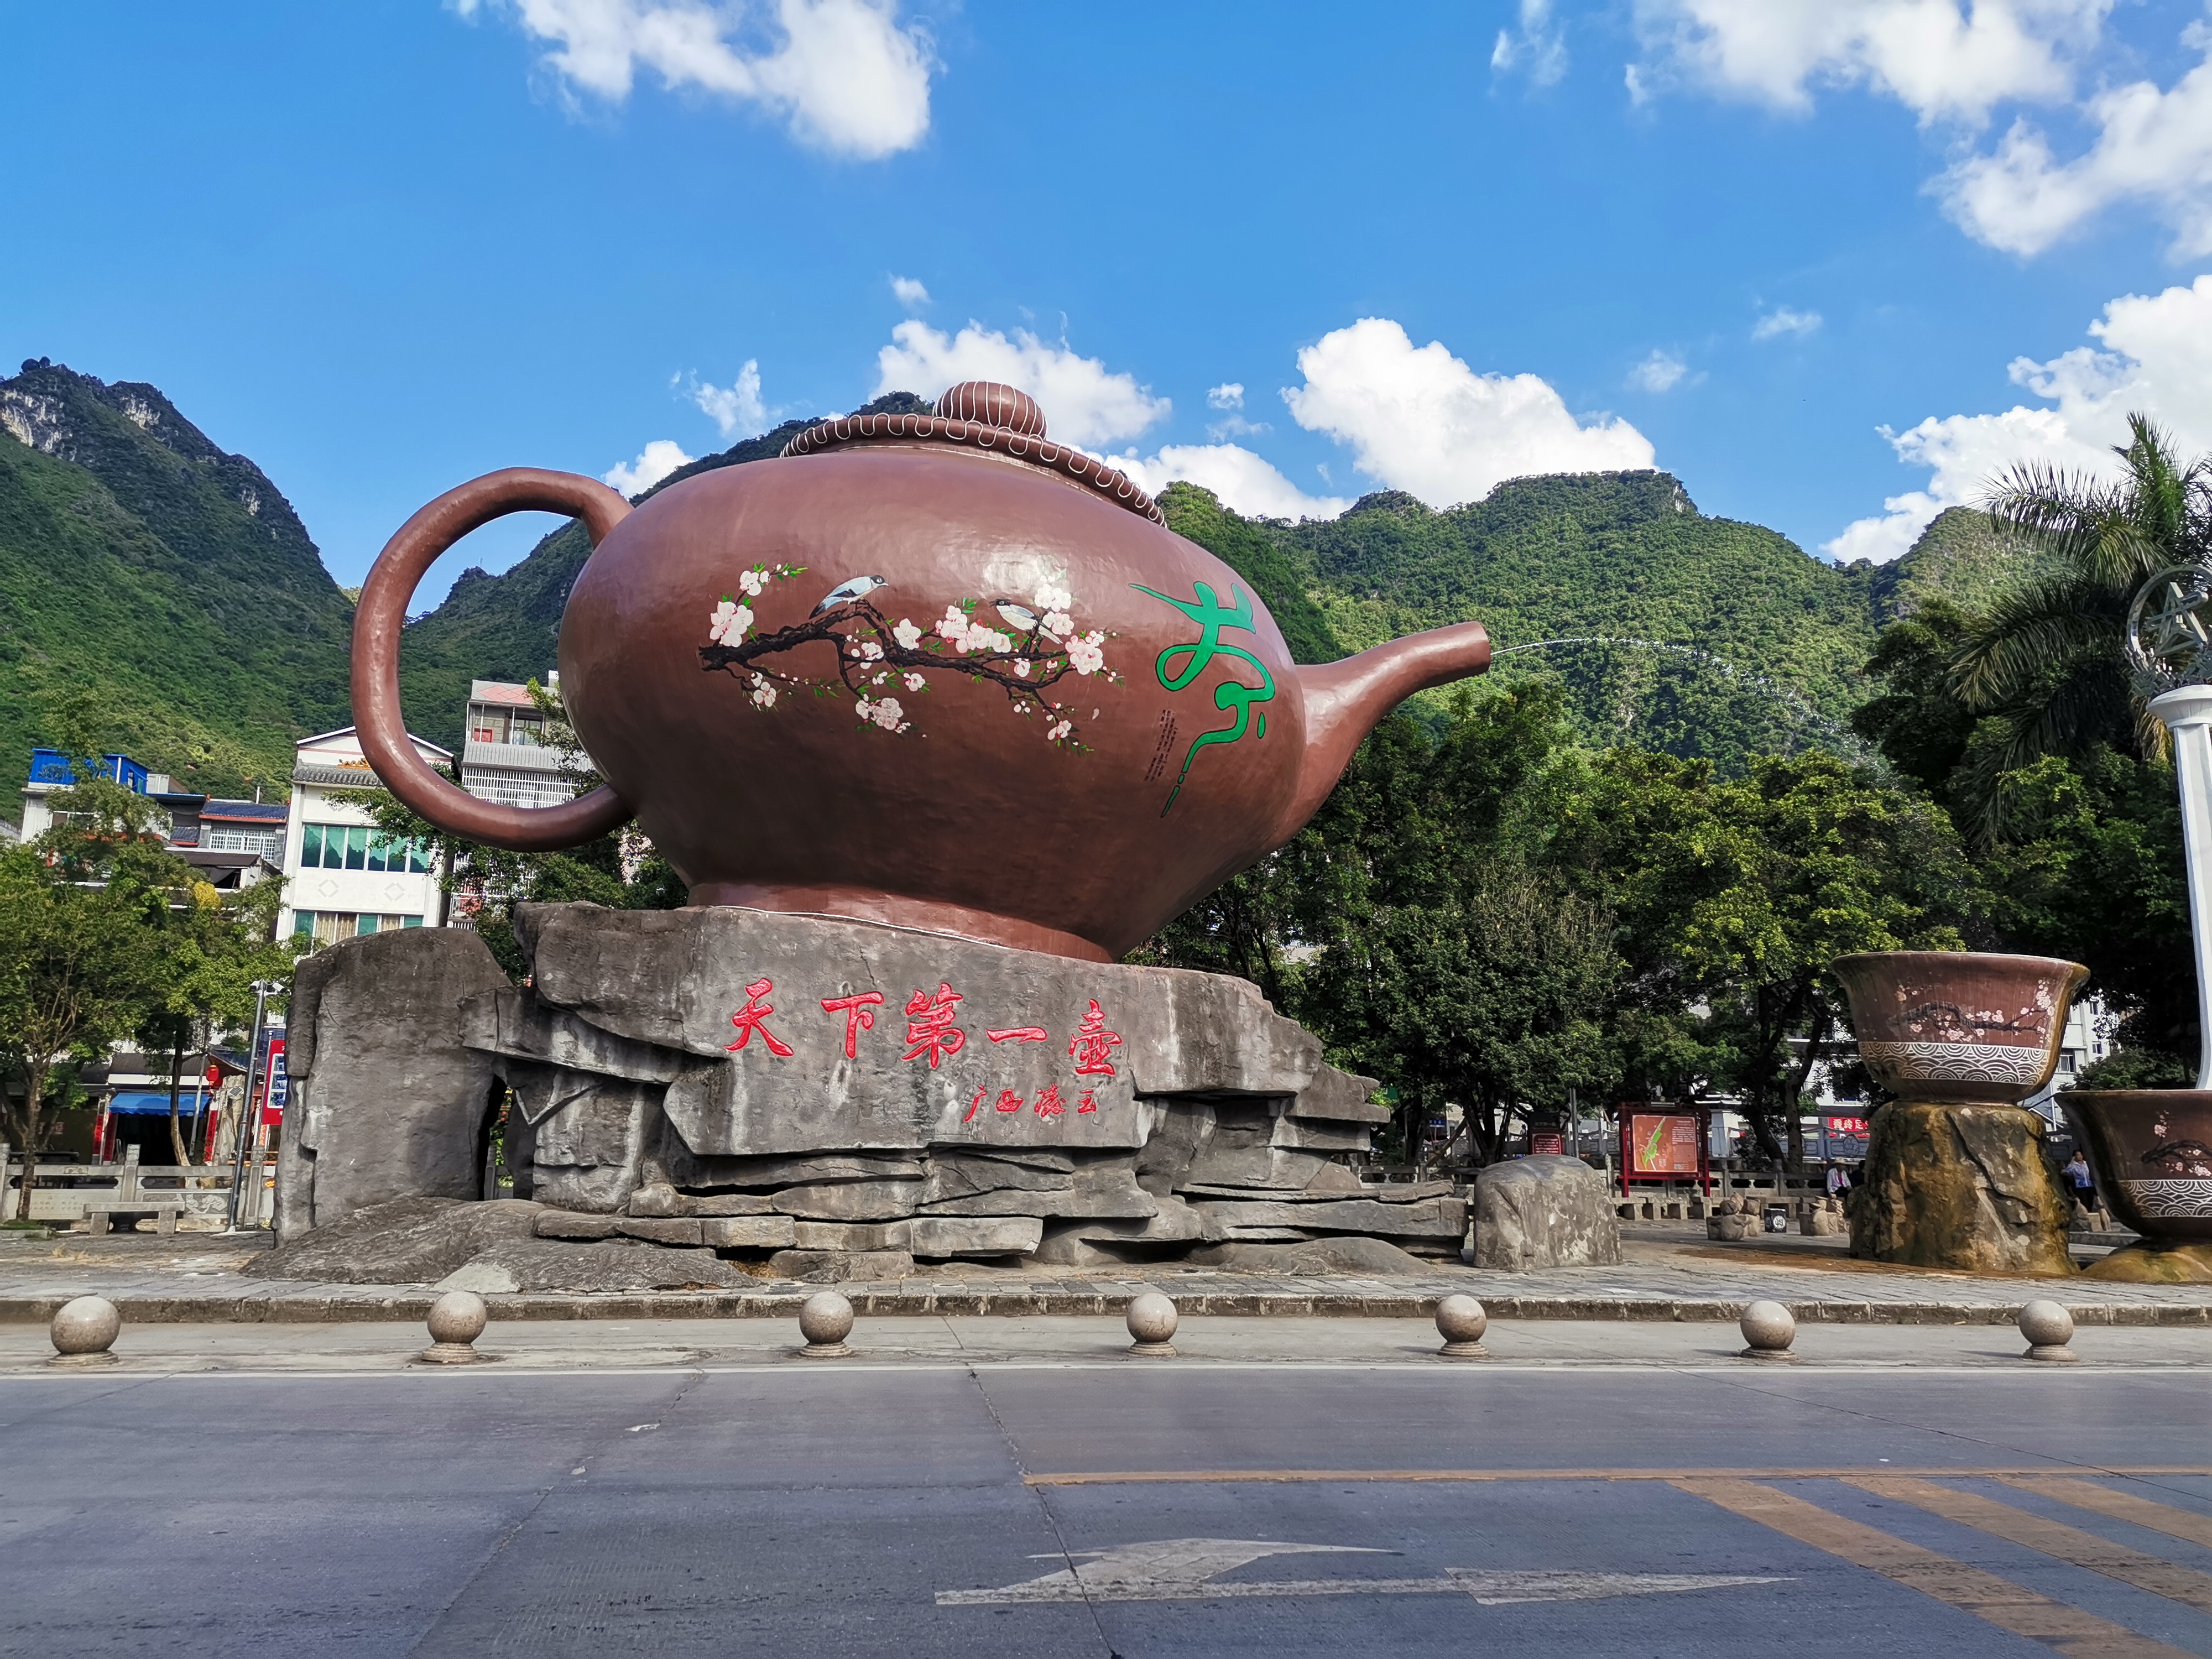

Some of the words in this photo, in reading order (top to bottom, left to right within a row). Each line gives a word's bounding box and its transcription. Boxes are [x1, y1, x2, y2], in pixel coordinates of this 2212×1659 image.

[723, 977, 1123, 1077] 天下第一壶
